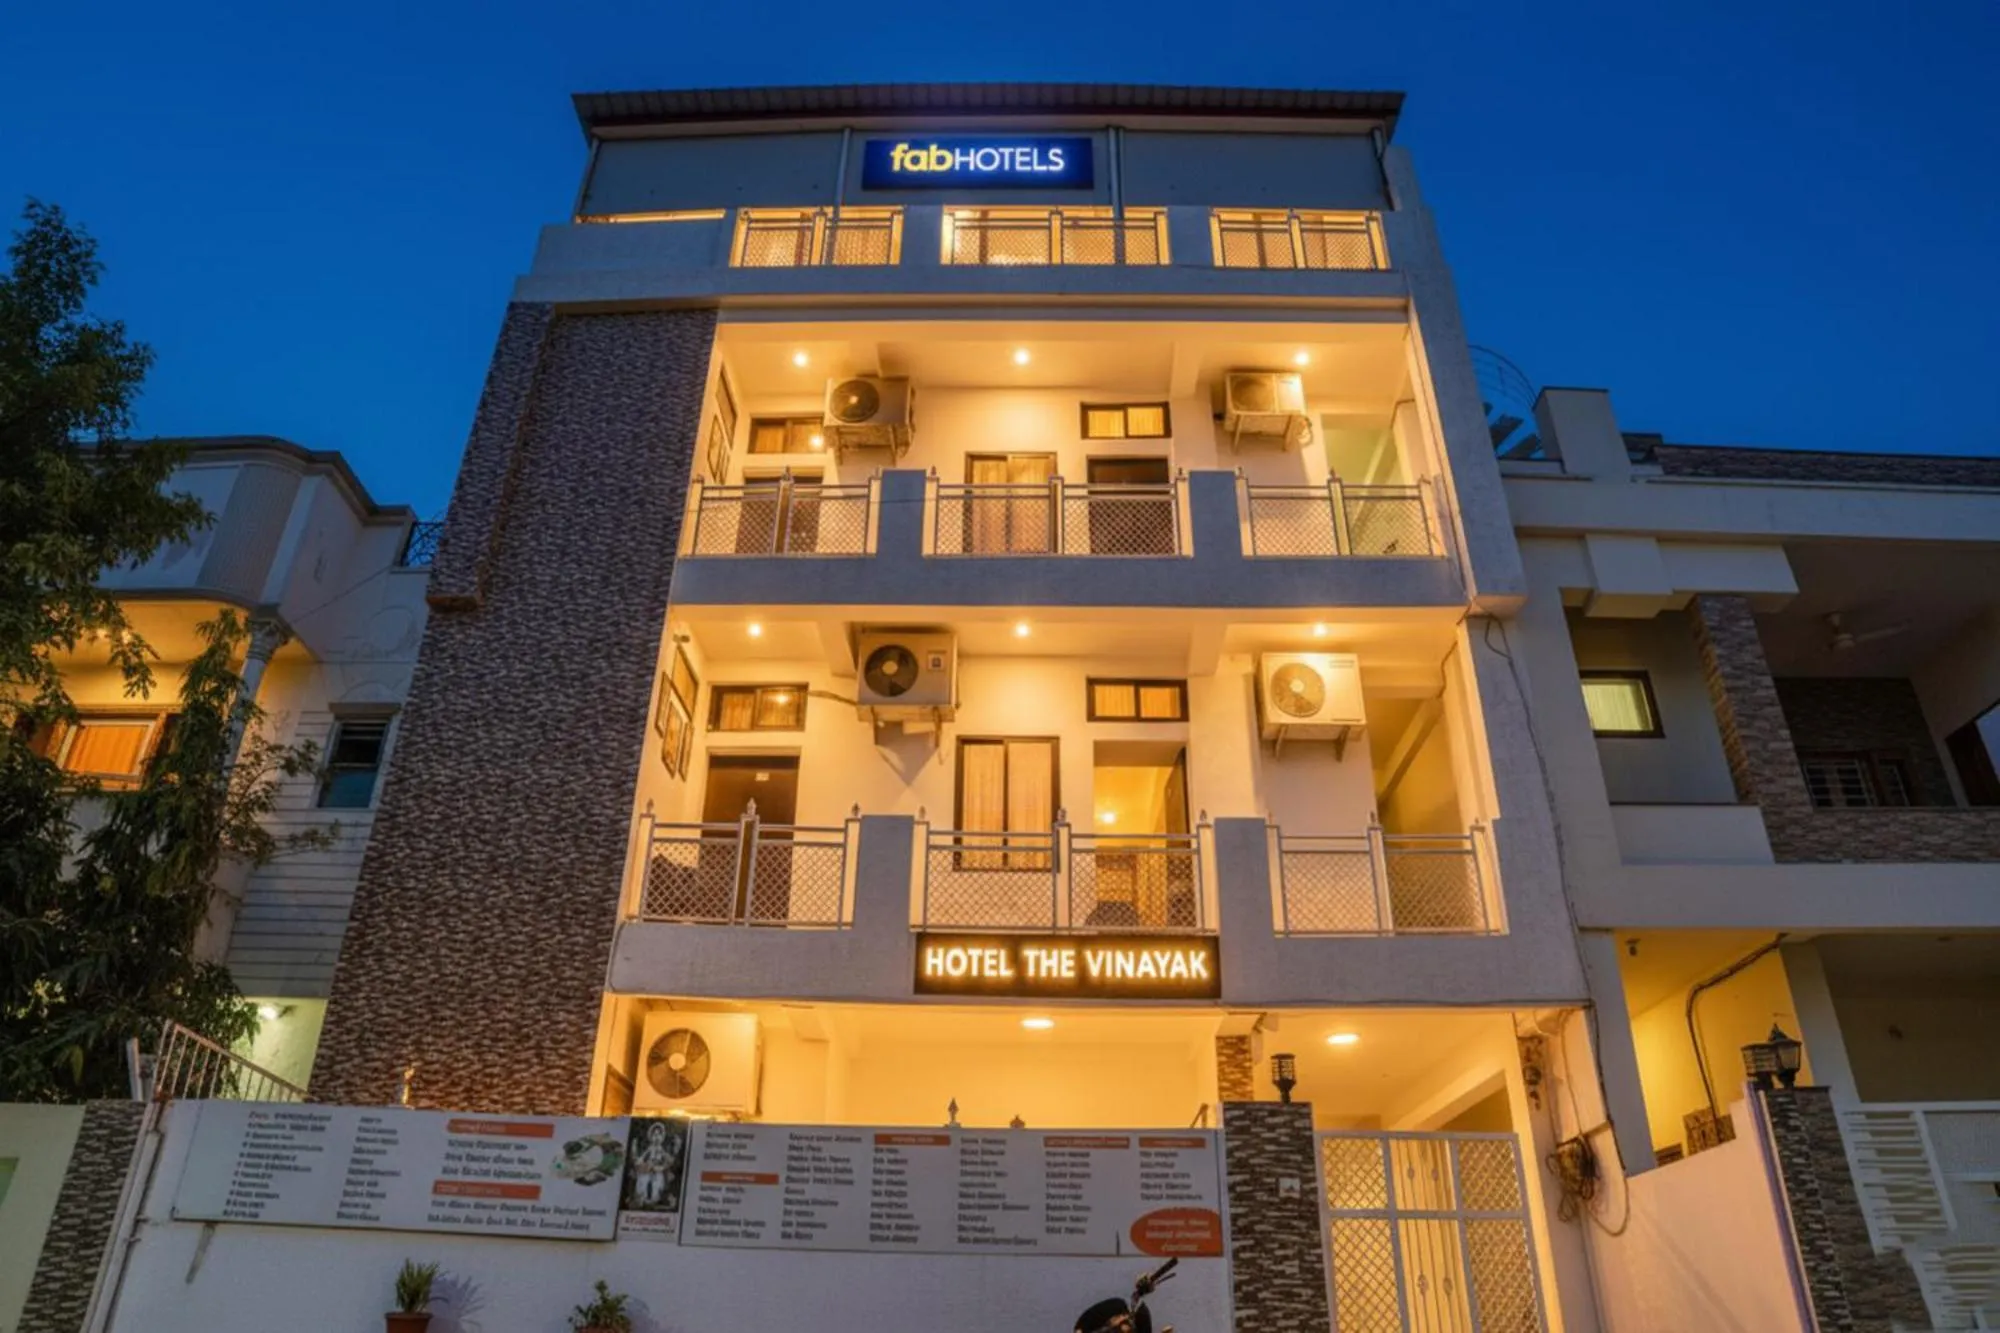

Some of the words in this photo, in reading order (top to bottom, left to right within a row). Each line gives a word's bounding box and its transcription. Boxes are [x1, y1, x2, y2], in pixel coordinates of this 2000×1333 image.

[890, 142, 1066, 173] fabHOTELS
[924, 946, 1014, 978] HOTEL
[1022, 947, 1076, 979] THE
[1084, 948, 1210, 980] VINAYAK
